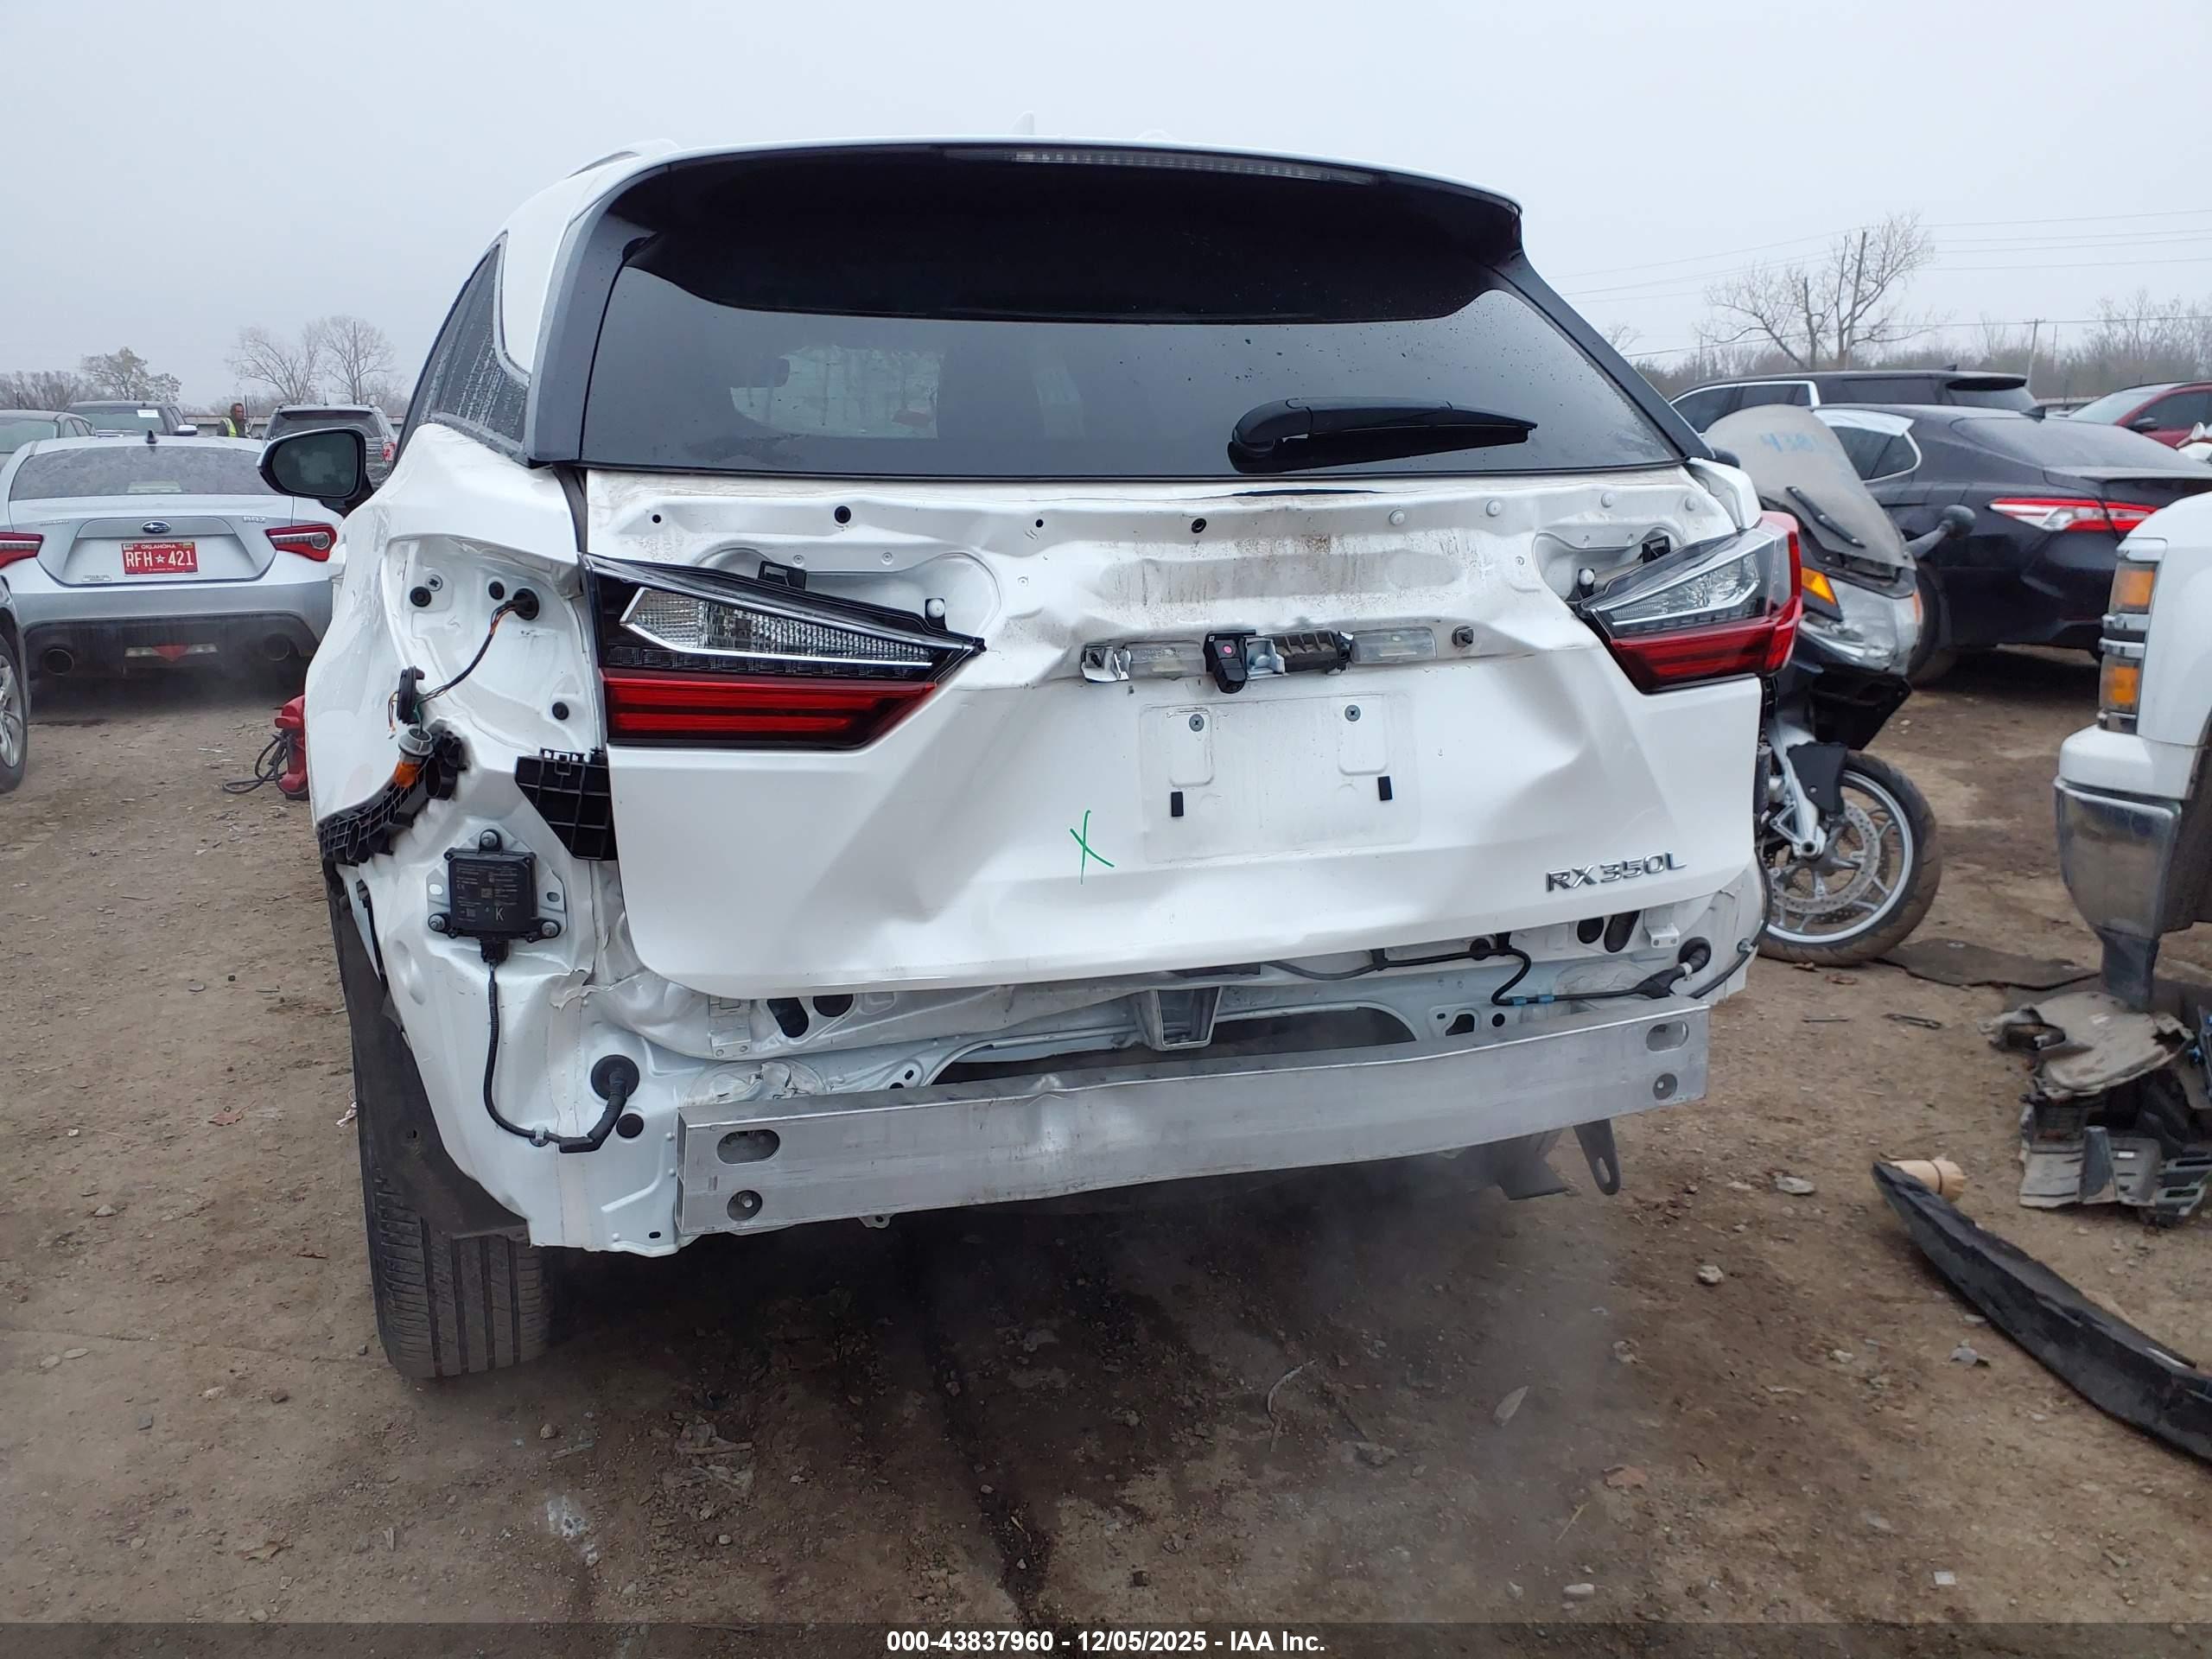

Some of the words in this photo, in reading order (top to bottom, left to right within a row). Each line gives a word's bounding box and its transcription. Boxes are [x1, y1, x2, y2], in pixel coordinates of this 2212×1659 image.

[124, 550, 153, 568] RFH
[168, 550, 194, 567] 421
[495, 906, 505, 921] K
